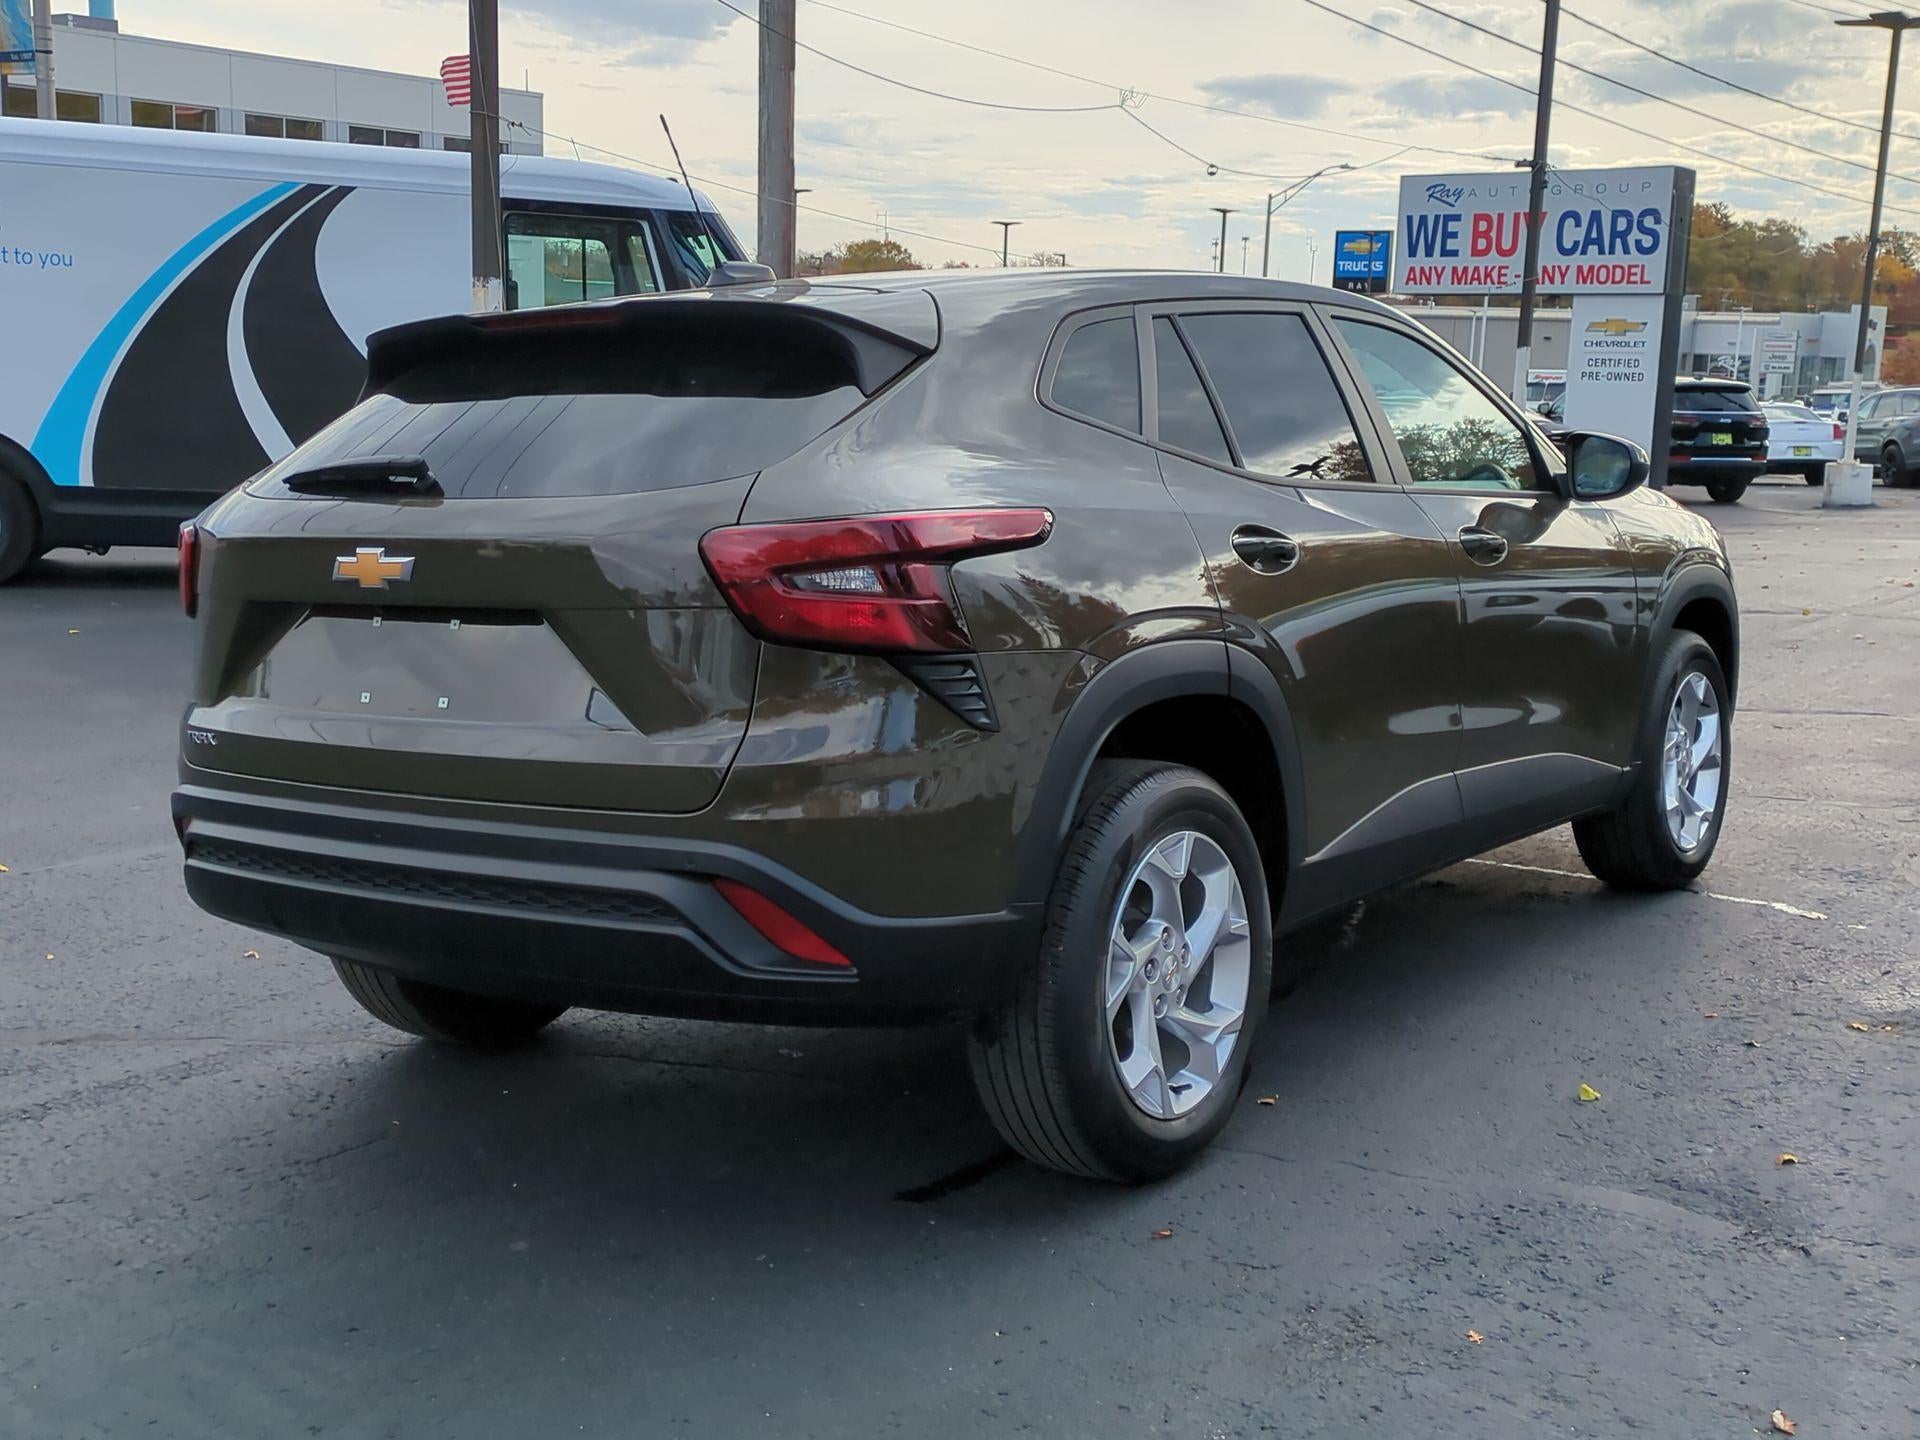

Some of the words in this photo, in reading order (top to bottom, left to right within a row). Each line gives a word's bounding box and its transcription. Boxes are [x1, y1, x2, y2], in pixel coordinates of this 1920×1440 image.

[1425, 183, 1464, 207] Ray
[1468, 185, 1532, 198] AUT
[1551, 181, 1653, 196] GROUP
[1406, 213, 1462, 258] WE
[1555, 207, 1662, 257] CARS
[13, 247, 33, 265] to
[38, 252, 73, 270] you
[1405, 266, 1446, 286] ANY
[1451, 265, 1509, 286] MAKE
[1535, 264, 1570, 285] NY
[1575, 263, 1652, 285] MODEL
[1584, 340, 1647, 348] CHEVROLET
[1587, 358, 1640, 368] CERTIFIED
[1580, 371, 1645, 382] PRE-OWNED
